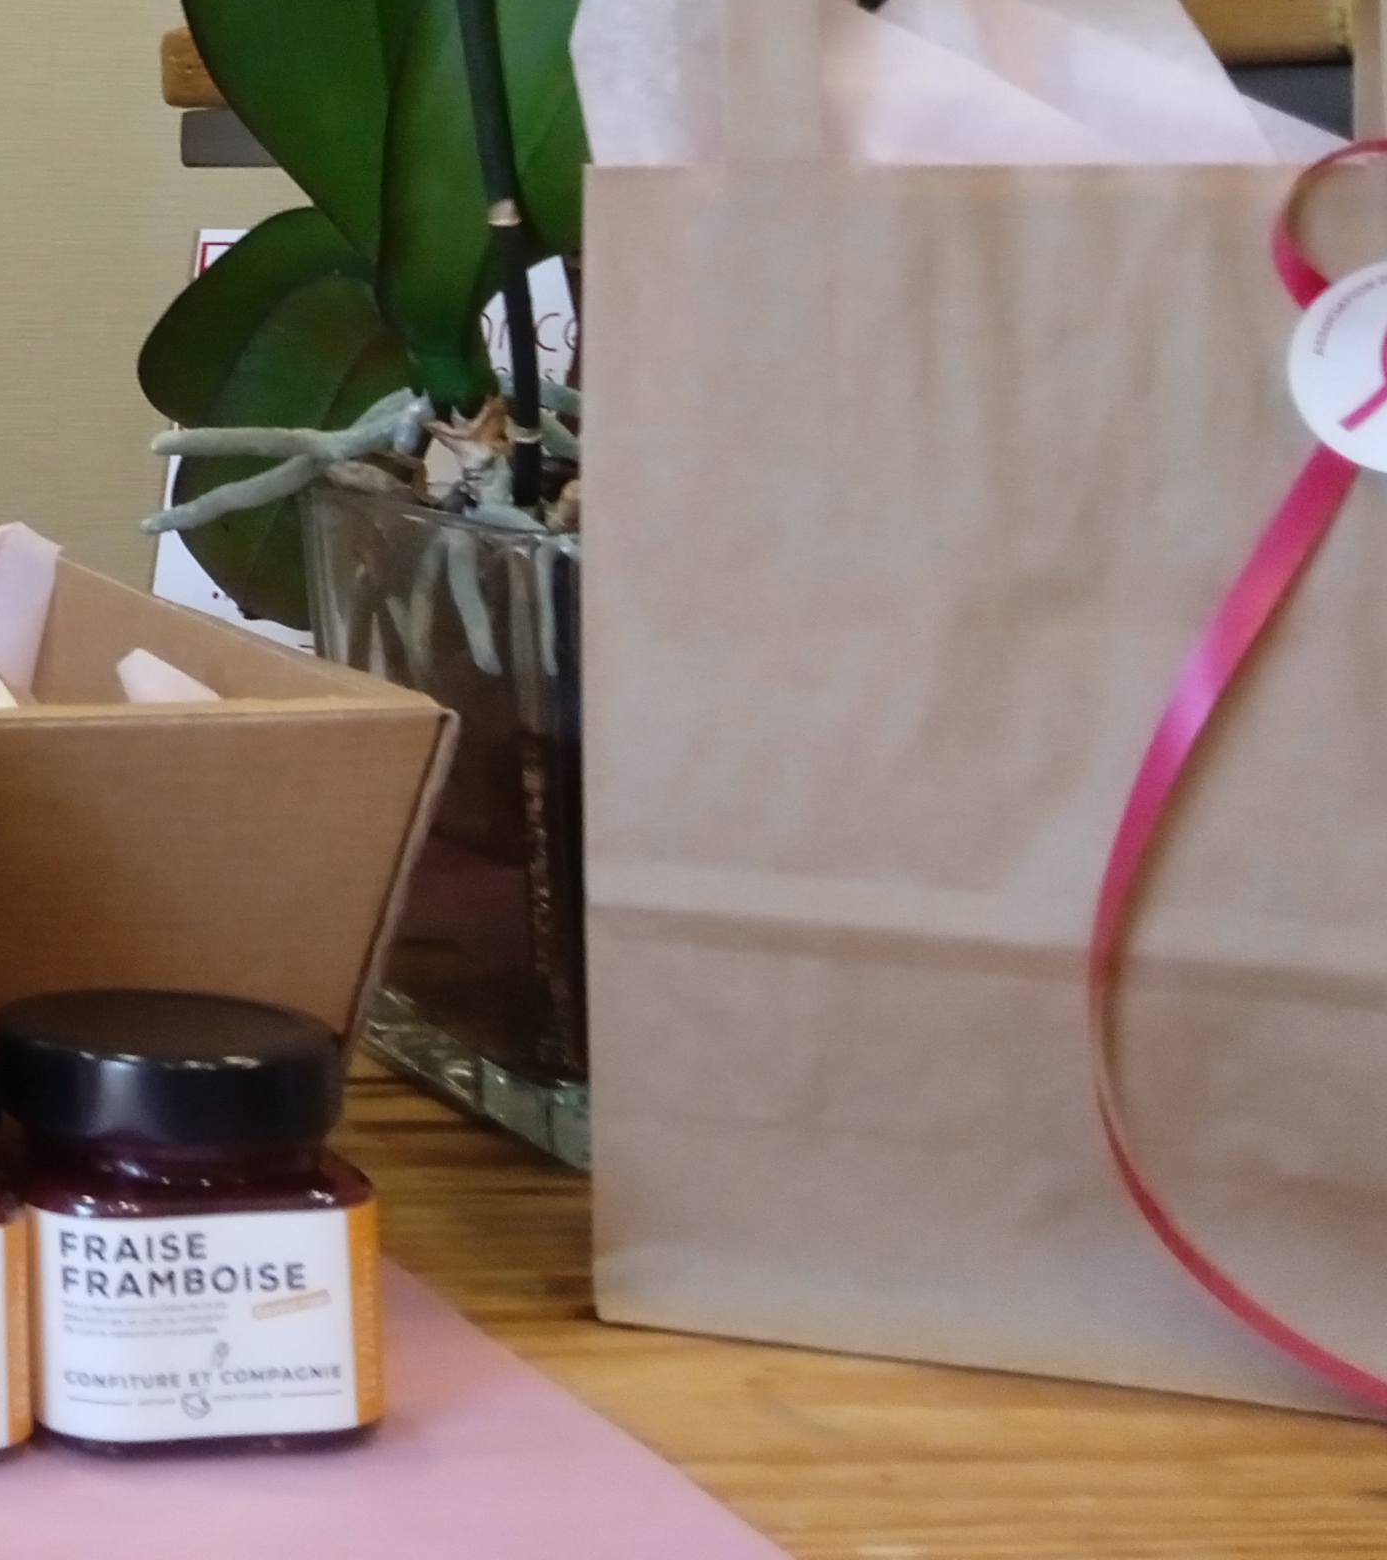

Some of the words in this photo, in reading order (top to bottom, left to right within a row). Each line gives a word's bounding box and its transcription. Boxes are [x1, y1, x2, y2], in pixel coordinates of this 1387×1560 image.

[57, 1228, 208, 1265] FRAISE
[60, 1261, 307, 1301] FRAMBOISE
[63, 1368, 181, 1391] CONFITURE
[188, 1370, 212, 1389] ET
[218, 1364, 343, 1386] COMPAGNIE
